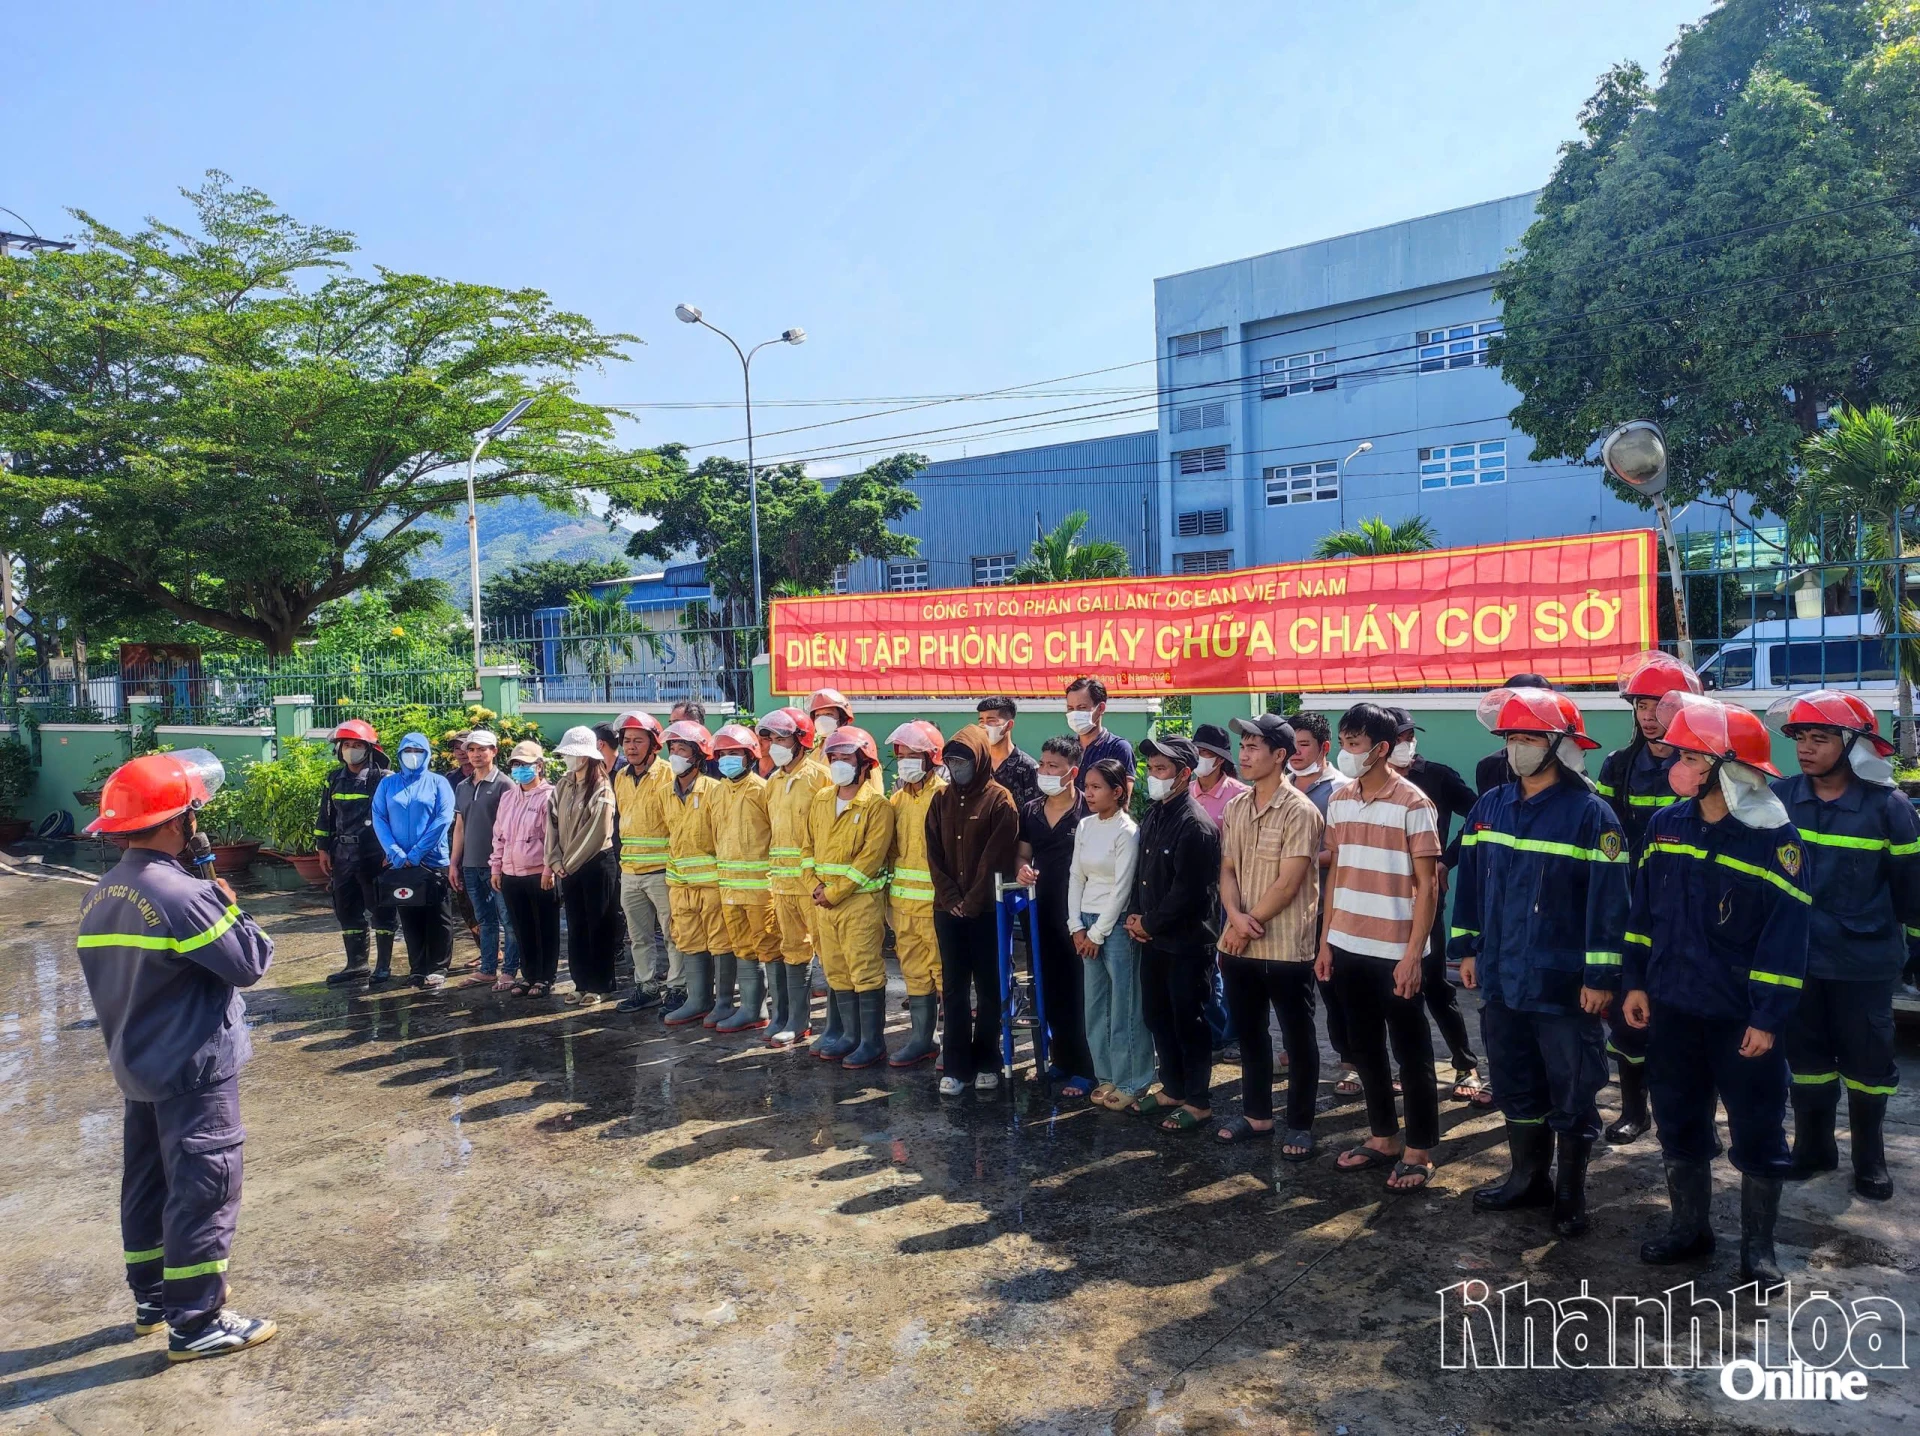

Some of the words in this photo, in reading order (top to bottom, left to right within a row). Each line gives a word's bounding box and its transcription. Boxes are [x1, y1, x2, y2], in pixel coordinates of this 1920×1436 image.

[923, 601, 968, 619] CÔNG
[974, 602, 994, 617] TY
[1077, 591, 1161, 613] GALLANT
[1165, 586, 1238, 608] OCEAN
[1243, 581, 1290, 605] VIỆT
[1297, 577, 1347, 598] NAM
[786, 633, 847, 668] DIỄN
[855, 633, 911, 673] TẬP
[919, 626, 1033, 667] PHÒNG
[1043, 621, 1146, 664] CHÁY
[1156, 614, 1277, 659] CHỮA
[1288, 603, 1422, 655] CHÁY
[1435, 603, 1518, 648] CƠ
[1533, 588, 1621, 643] SỞ
[107, 885, 129, 898] PCCC
[137, 898, 161, 928] CNCH
